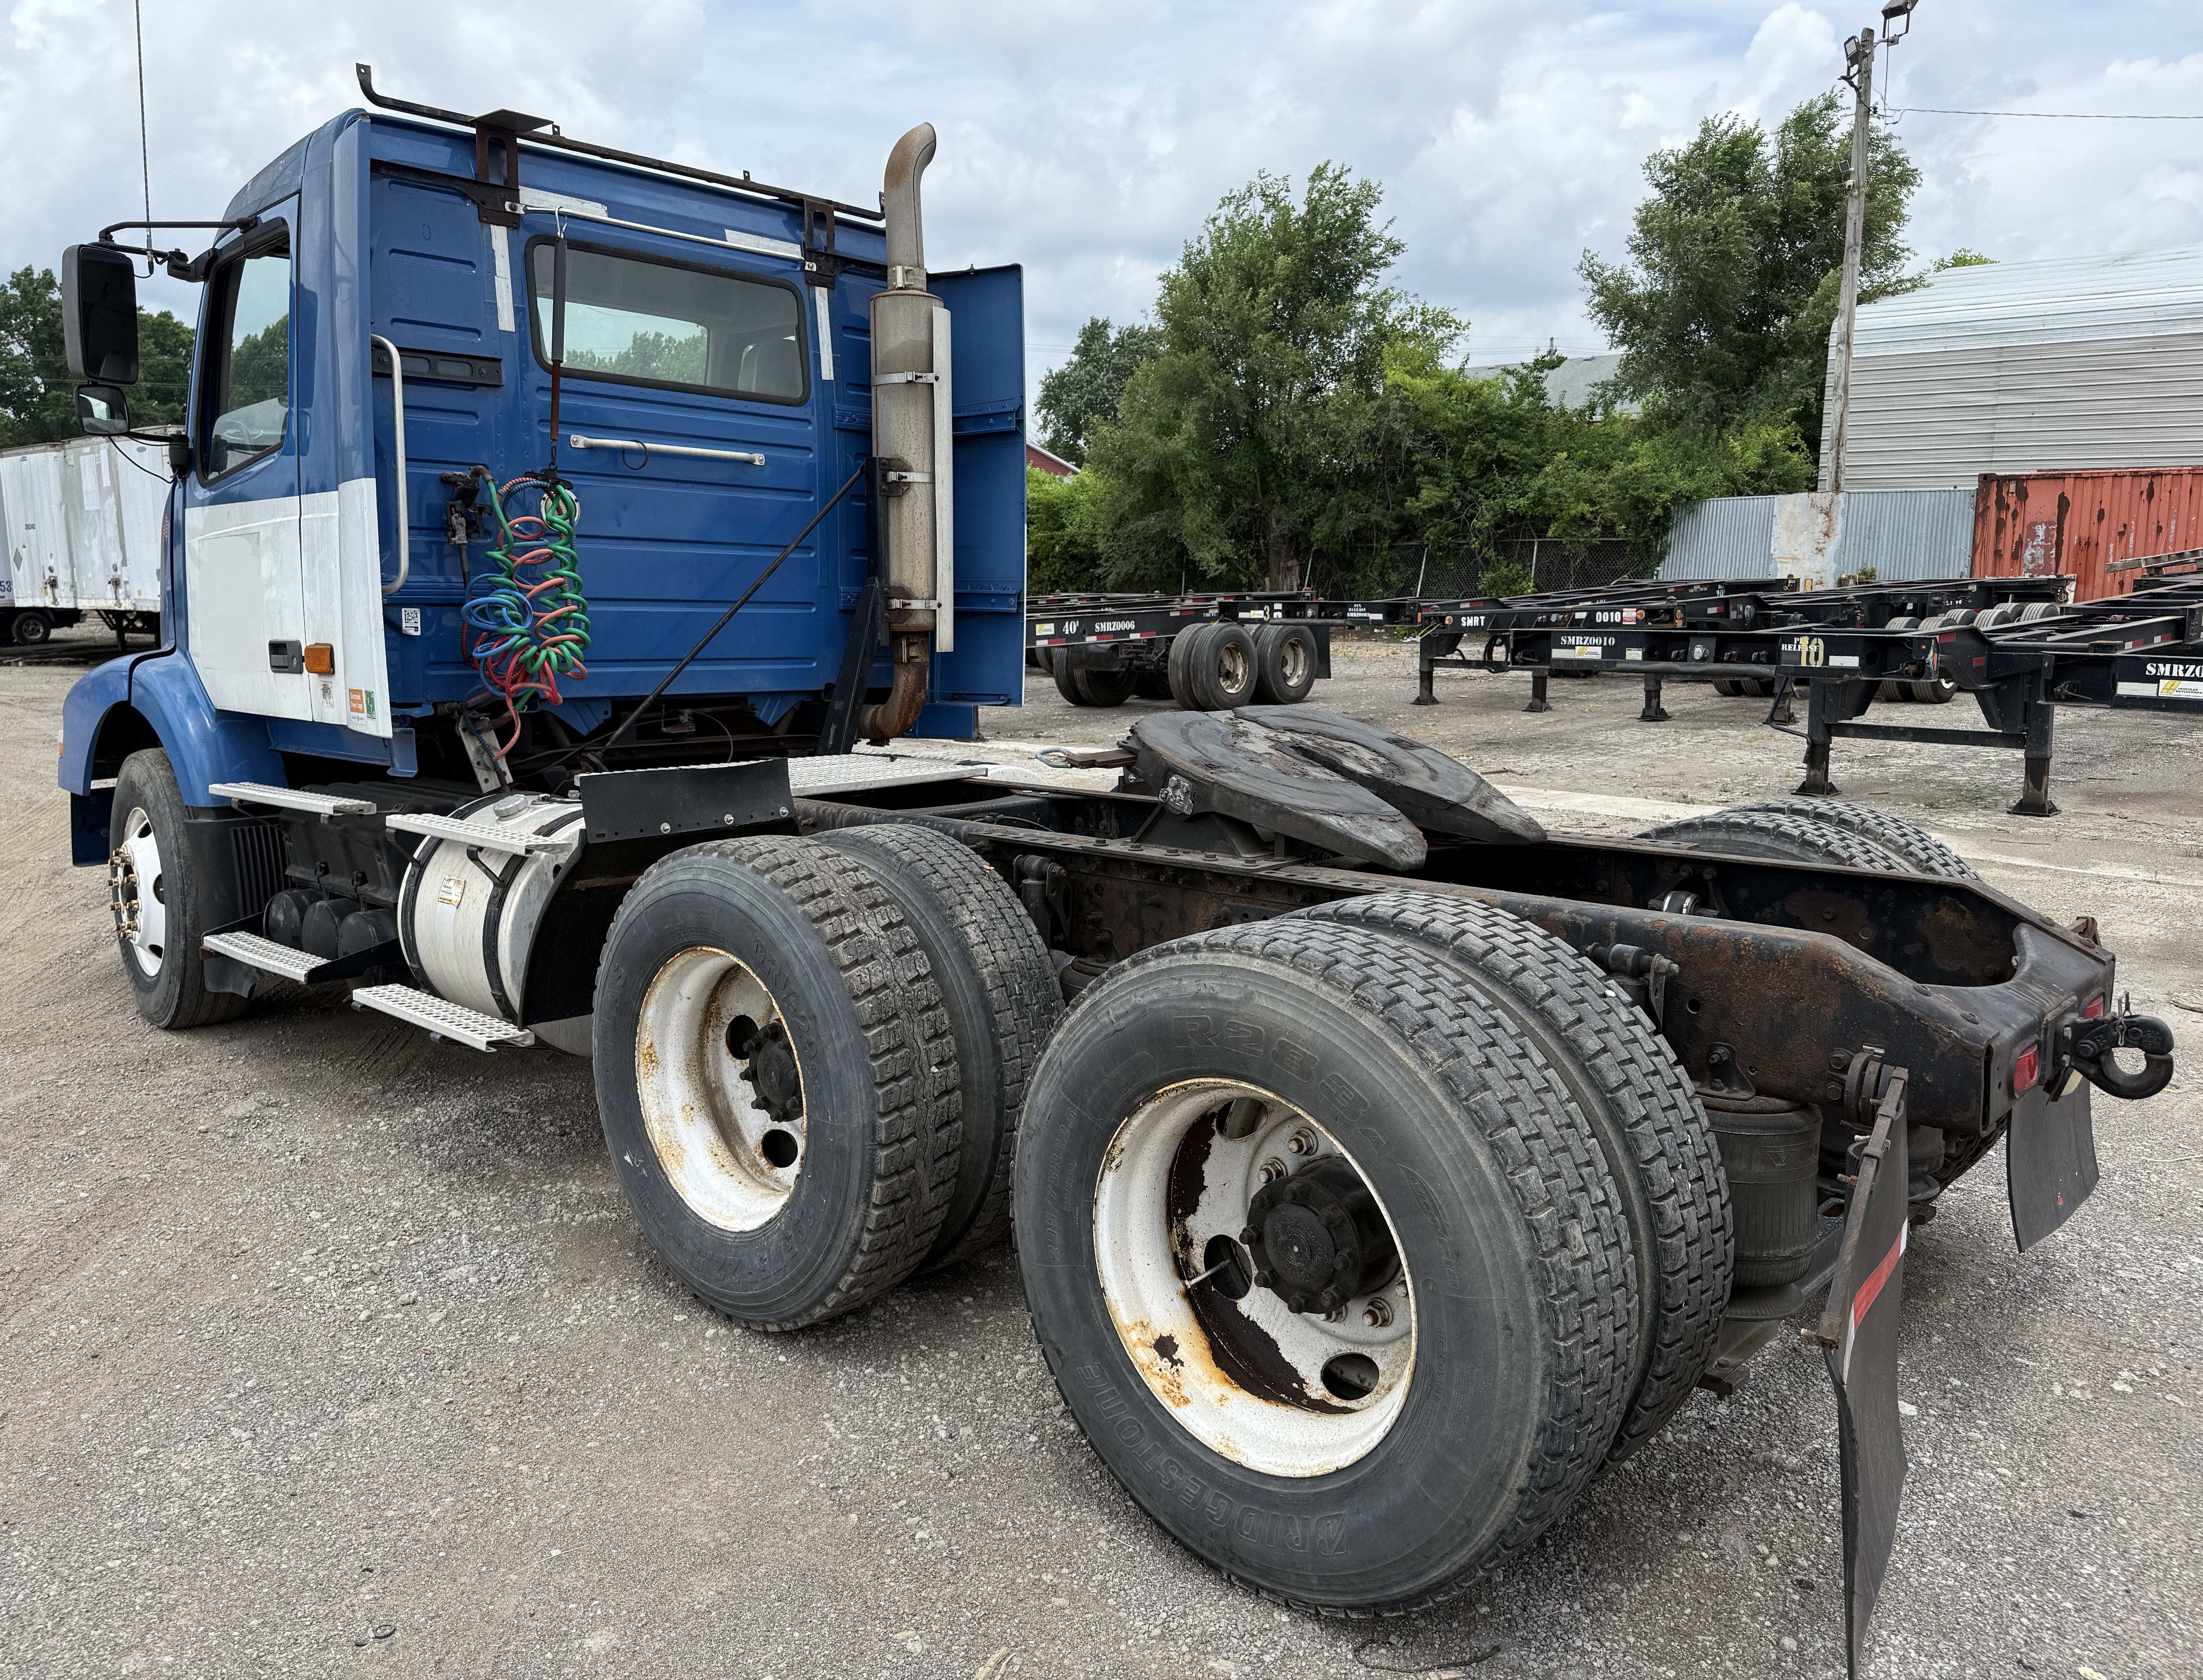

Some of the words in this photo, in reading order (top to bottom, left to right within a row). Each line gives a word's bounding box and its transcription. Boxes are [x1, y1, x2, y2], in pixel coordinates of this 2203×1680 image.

[1263, 605, 1270, 621] 3
[1461, 616, 1486, 627] SMRT
[1596, 611, 1621, 623] 0010
[1062, 620, 1079, 634] 40'
[1095, 620, 1136, 632] SMRZ0006
[1560, 636, 1615, 646] SMRZ0010
[1800, 635, 1824, 667] 10
[1242, 1012, 1281, 1032] STEEL
[1283, 1026, 1307, 1044] RIB
[1064, 1163, 1077, 1213] RADIAL
[1433, 1327, 1446, 1401] REGROOVABLE
[1076, 1362, 1348, 1557] BRIDGESTONE
